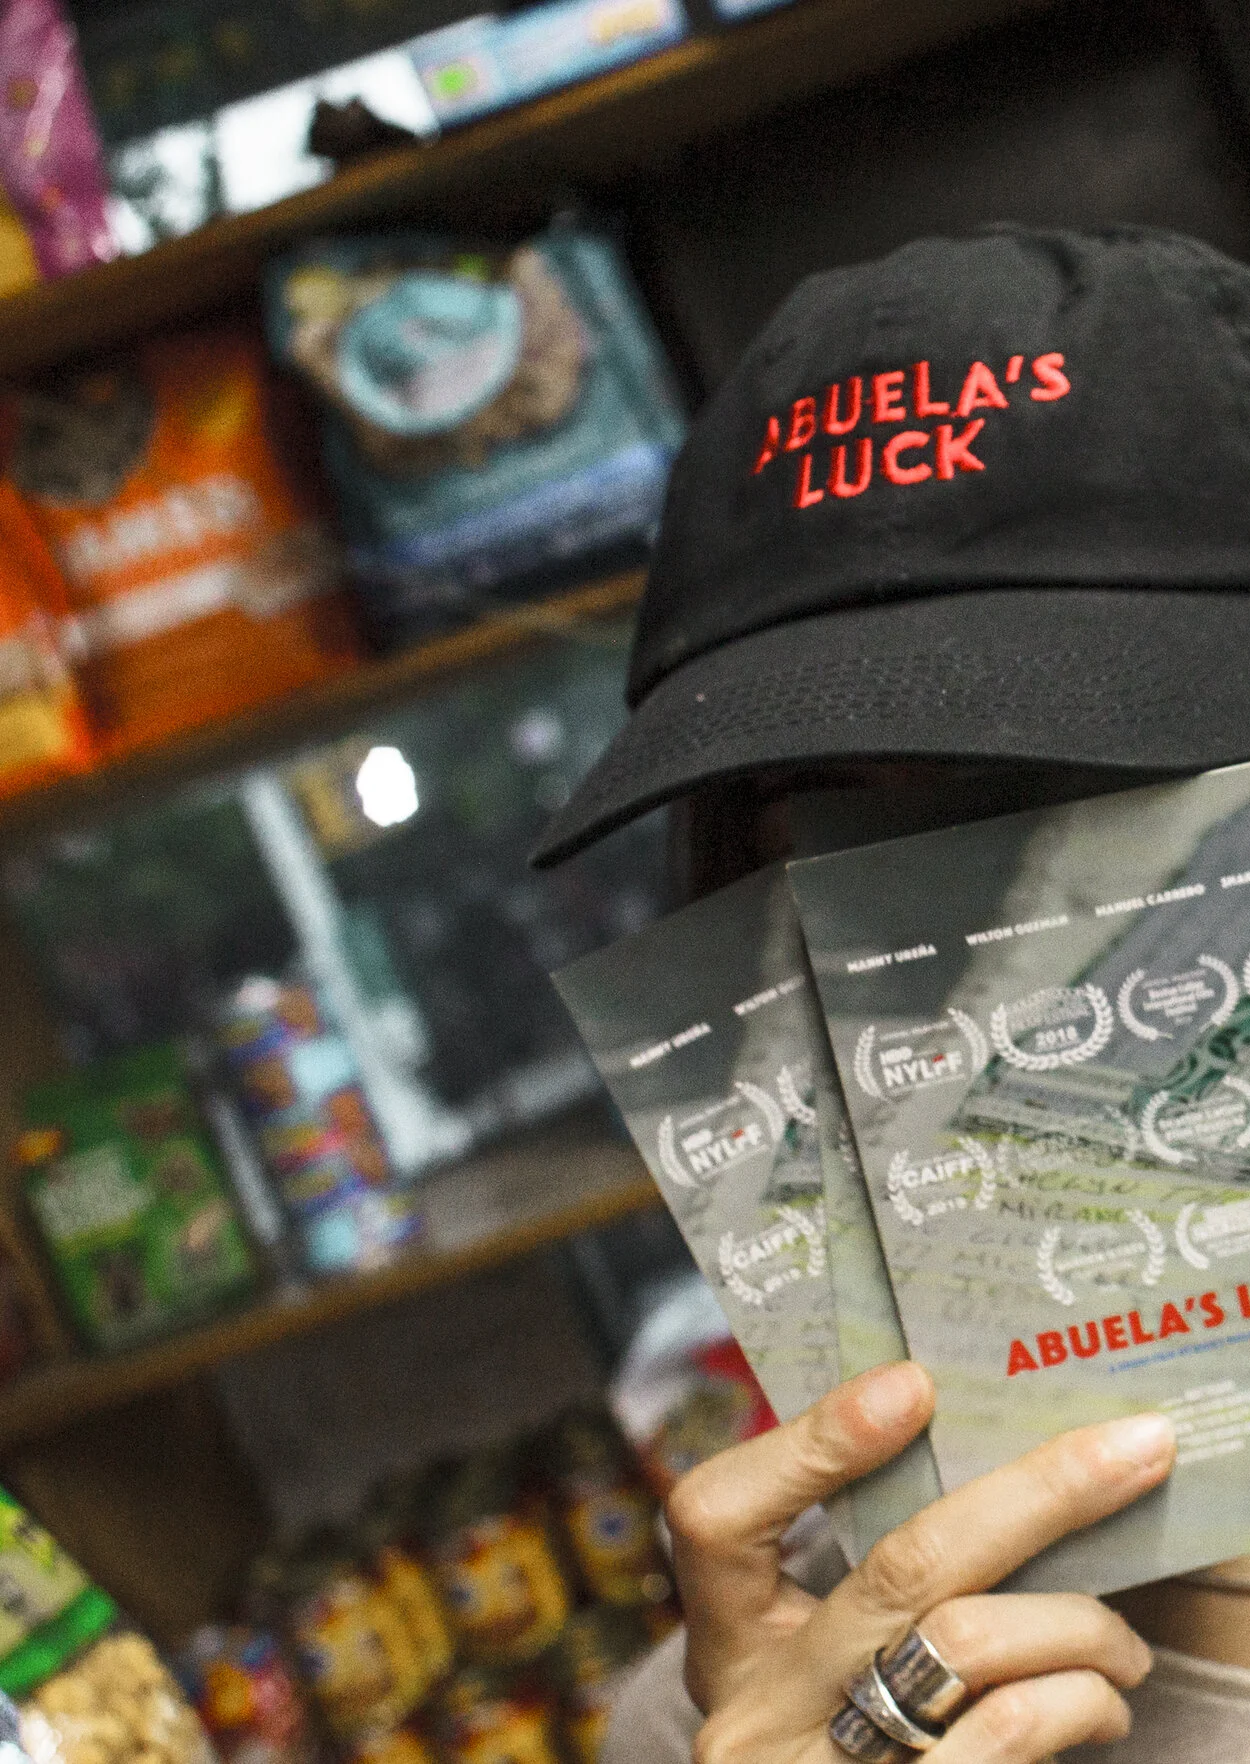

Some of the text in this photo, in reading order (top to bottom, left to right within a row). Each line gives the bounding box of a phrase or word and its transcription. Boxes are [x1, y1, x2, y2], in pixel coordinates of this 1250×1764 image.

[752, 351, 1071, 475] ABUELA'S
[793, 418, 986, 509] LUCK
[1006, 1290, 1225, 1377] ABUELA'S
